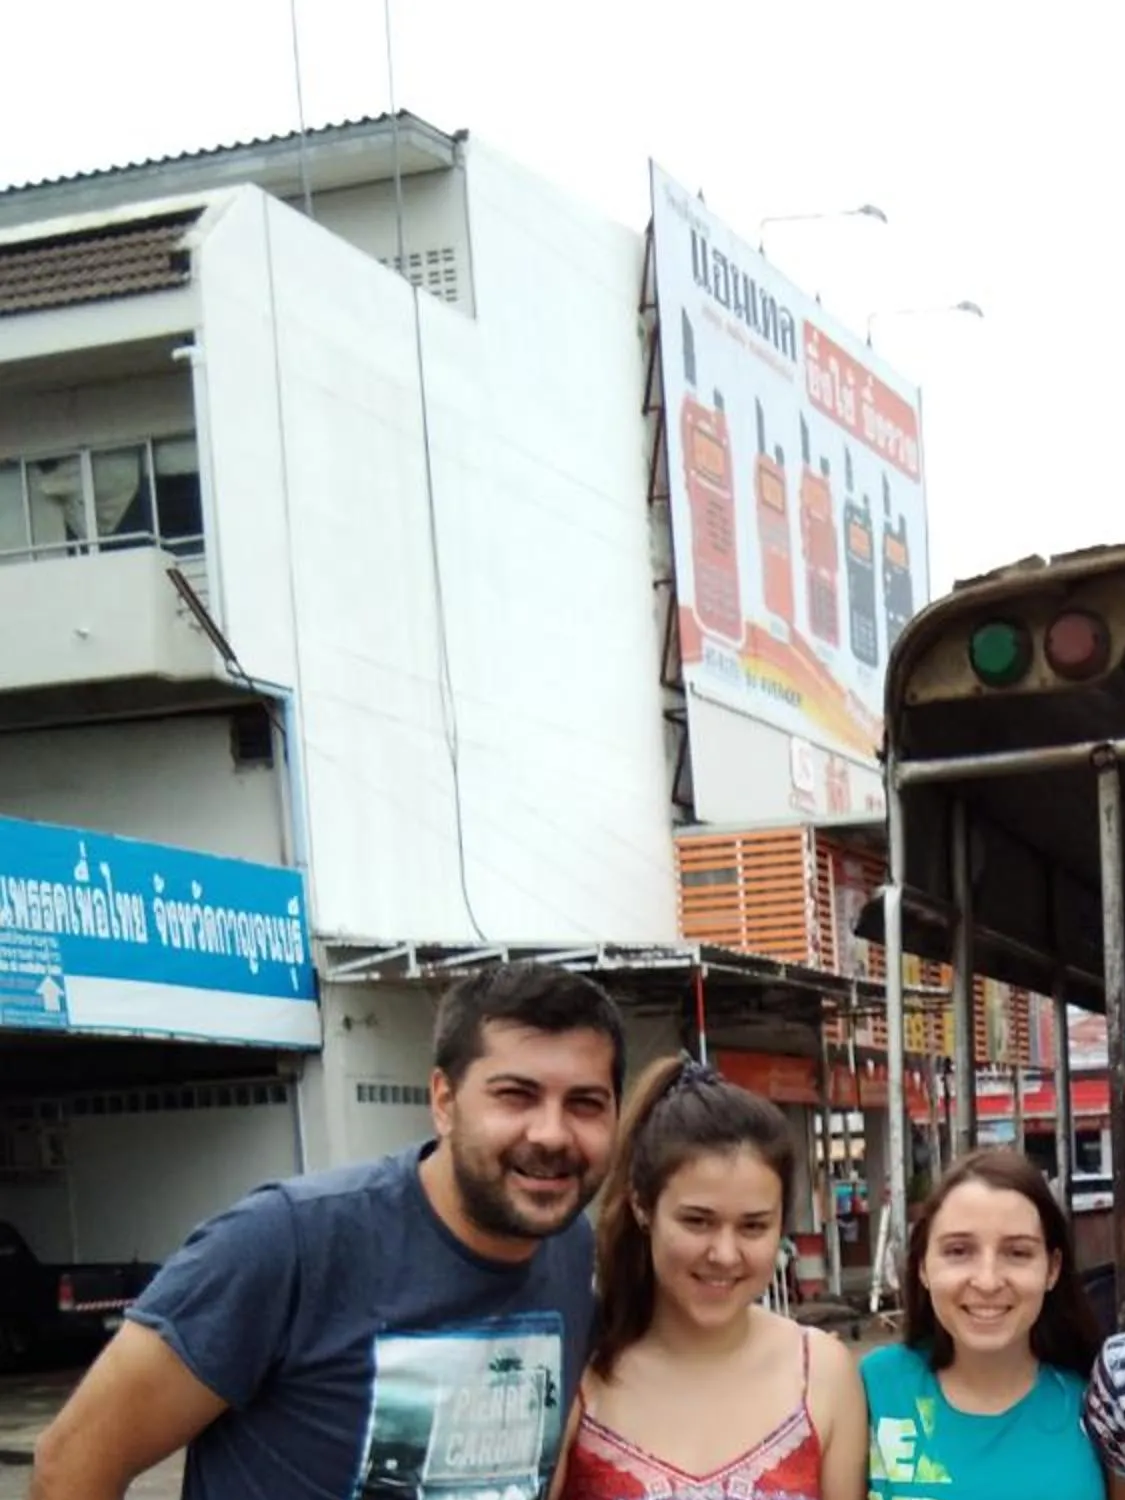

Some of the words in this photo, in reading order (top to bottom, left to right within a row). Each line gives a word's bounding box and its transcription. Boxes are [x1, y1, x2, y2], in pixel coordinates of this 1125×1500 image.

[153, 873, 304, 992] จังหวัดกาญจนบุรี
